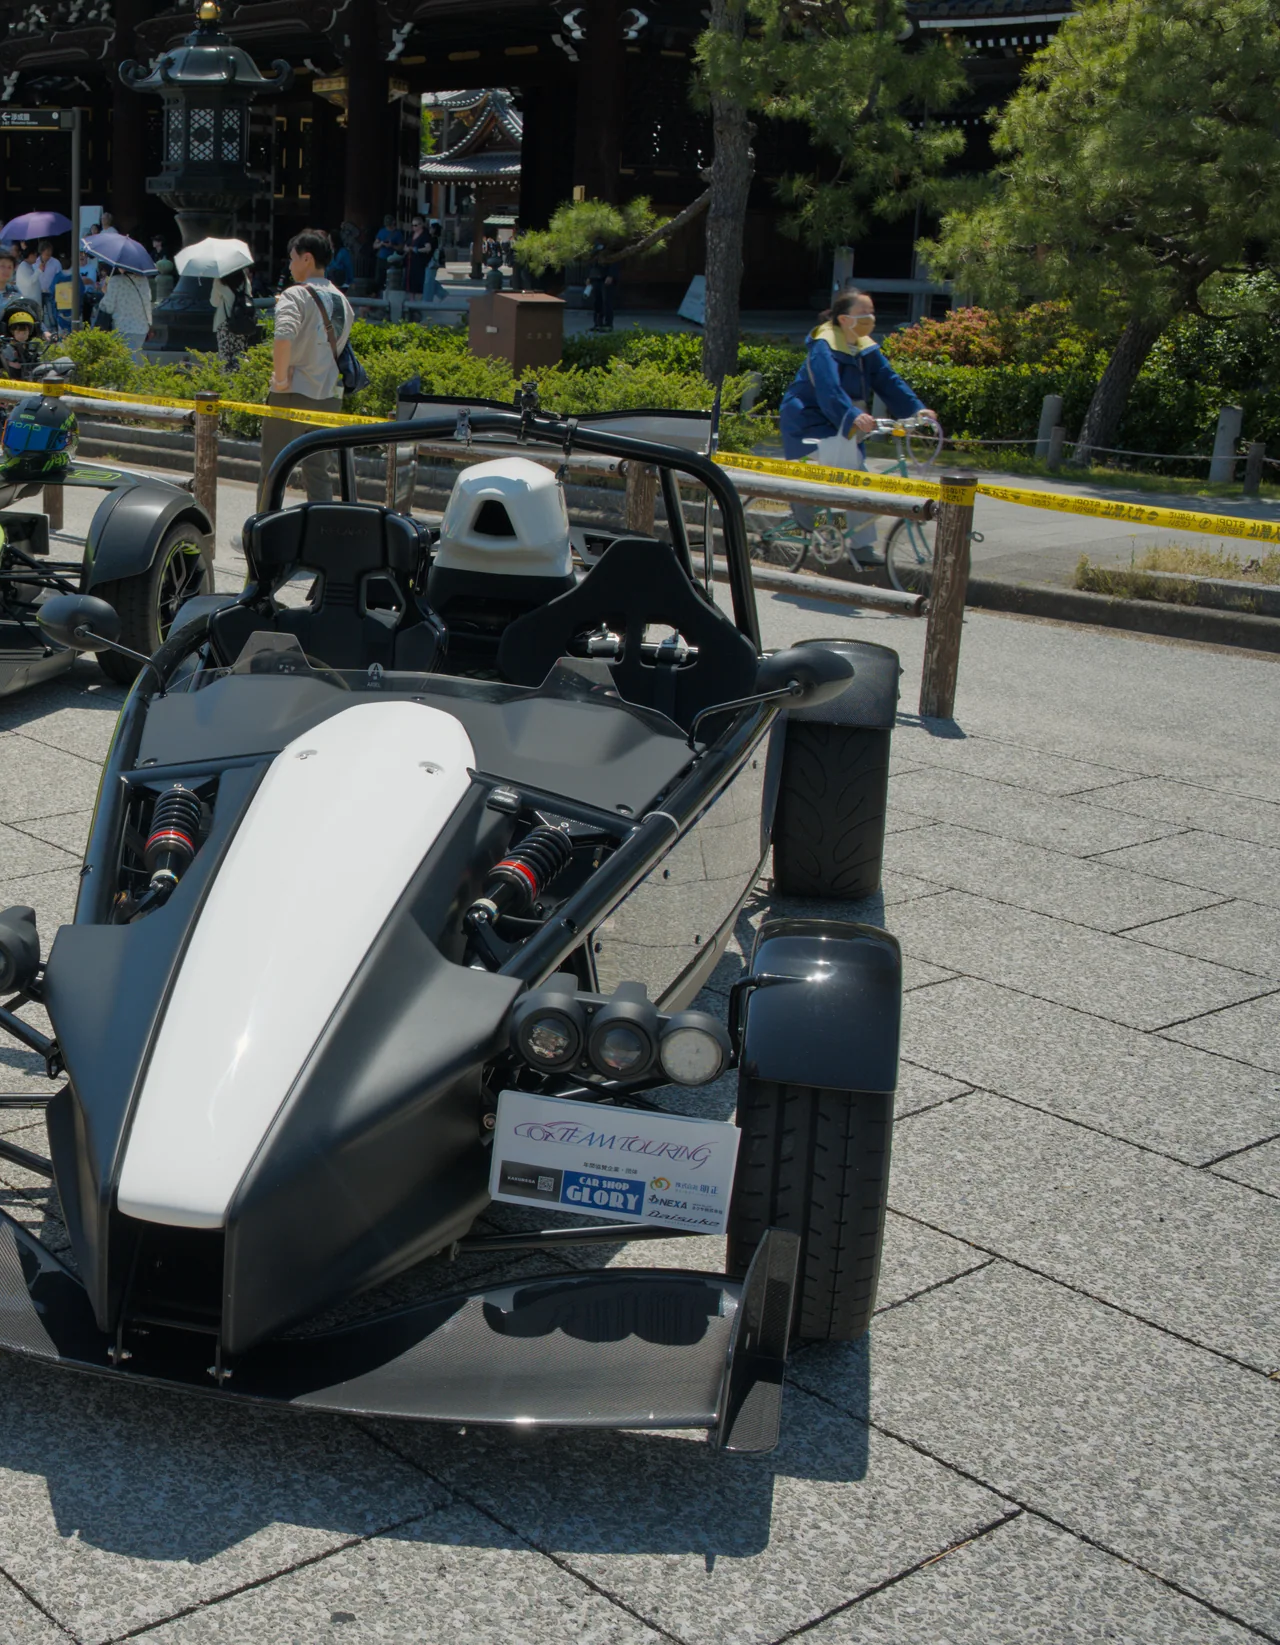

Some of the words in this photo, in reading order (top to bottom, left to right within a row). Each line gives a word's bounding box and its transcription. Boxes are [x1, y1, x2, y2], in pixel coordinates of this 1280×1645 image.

[557, 1127, 615, 1150] TEAM
[619, 1135, 719, 1171] TOURING
[579, 1176, 599, 1187] CAR
[602, 1179, 630, 1191] SHOP
[566, 1184, 639, 1211] GLORY
[660, 1198, 688, 1210] NEXA
[646, 1209, 720, 1227] Daisuke
